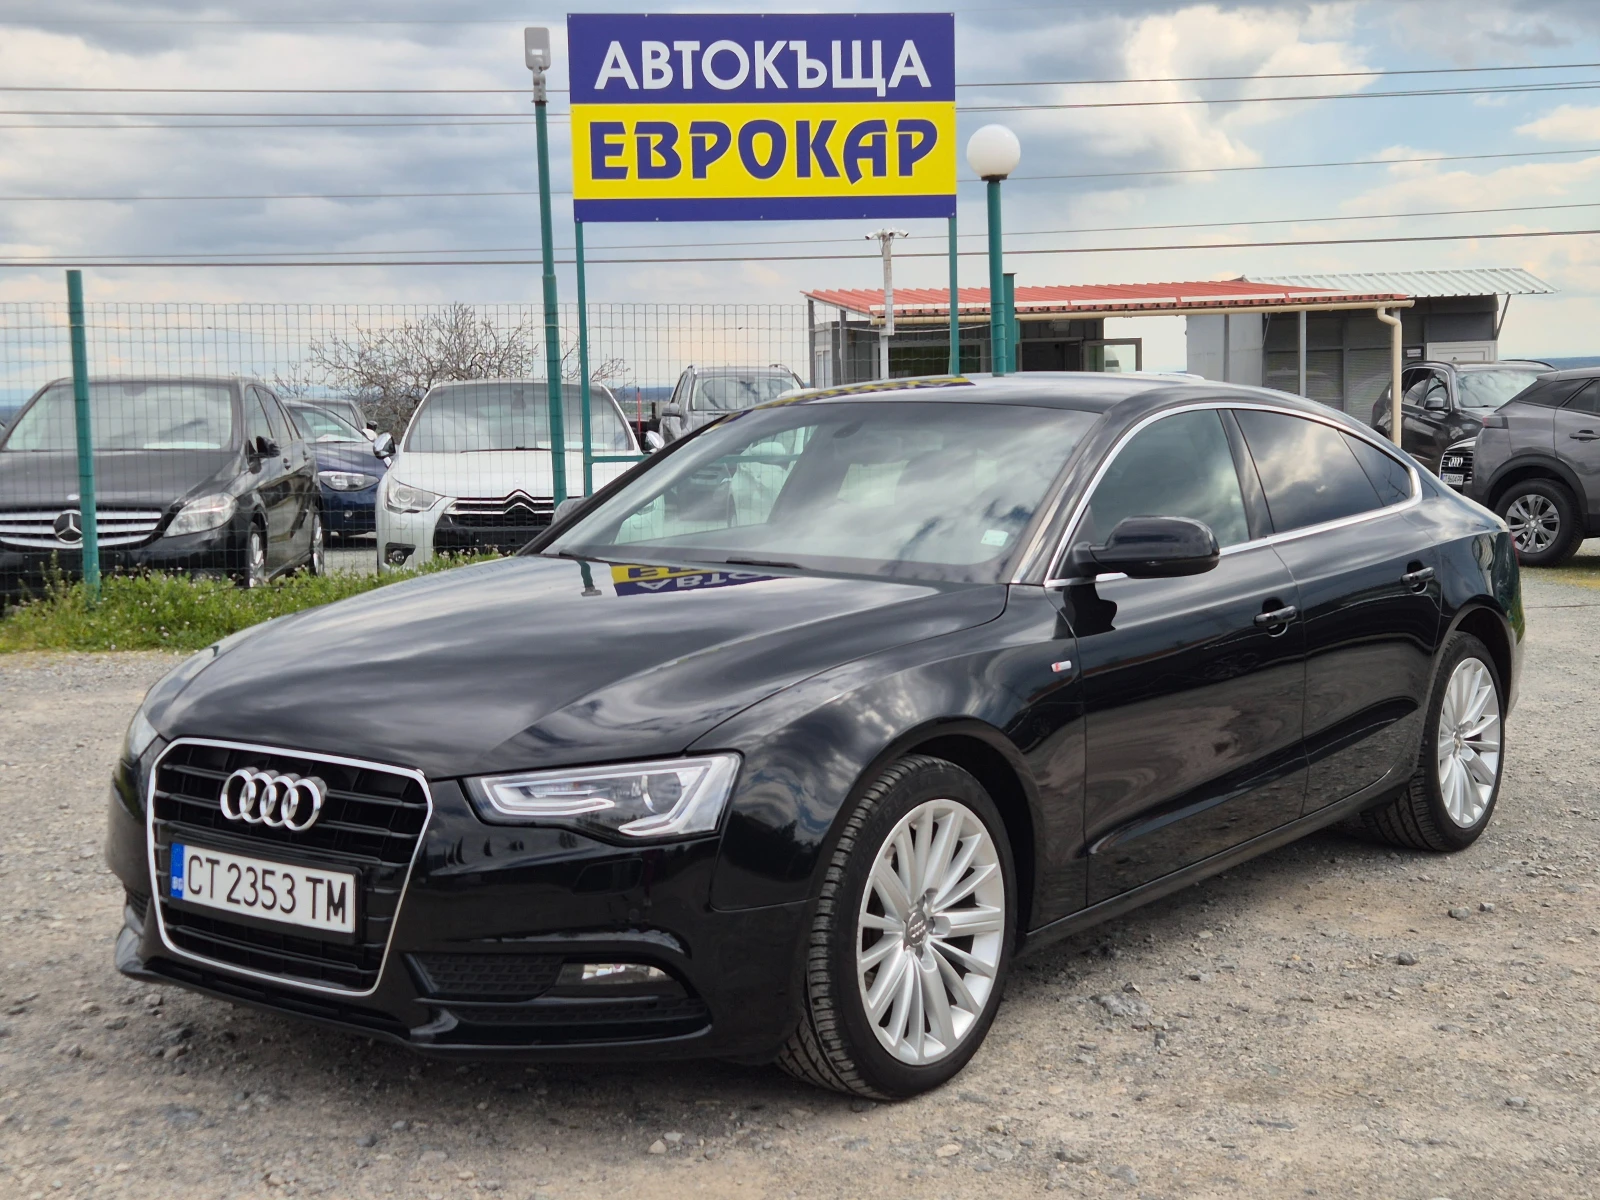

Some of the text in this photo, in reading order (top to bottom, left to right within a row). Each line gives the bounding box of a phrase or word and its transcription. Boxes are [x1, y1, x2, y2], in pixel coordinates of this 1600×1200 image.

[594, 39, 932, 97] АВТОКЪЩА
[589, 119, 938, 185] ЕВРОКАР
[172, 876, 183, 891] BG
[188, 854, 346, 924] CT 2353 TM
